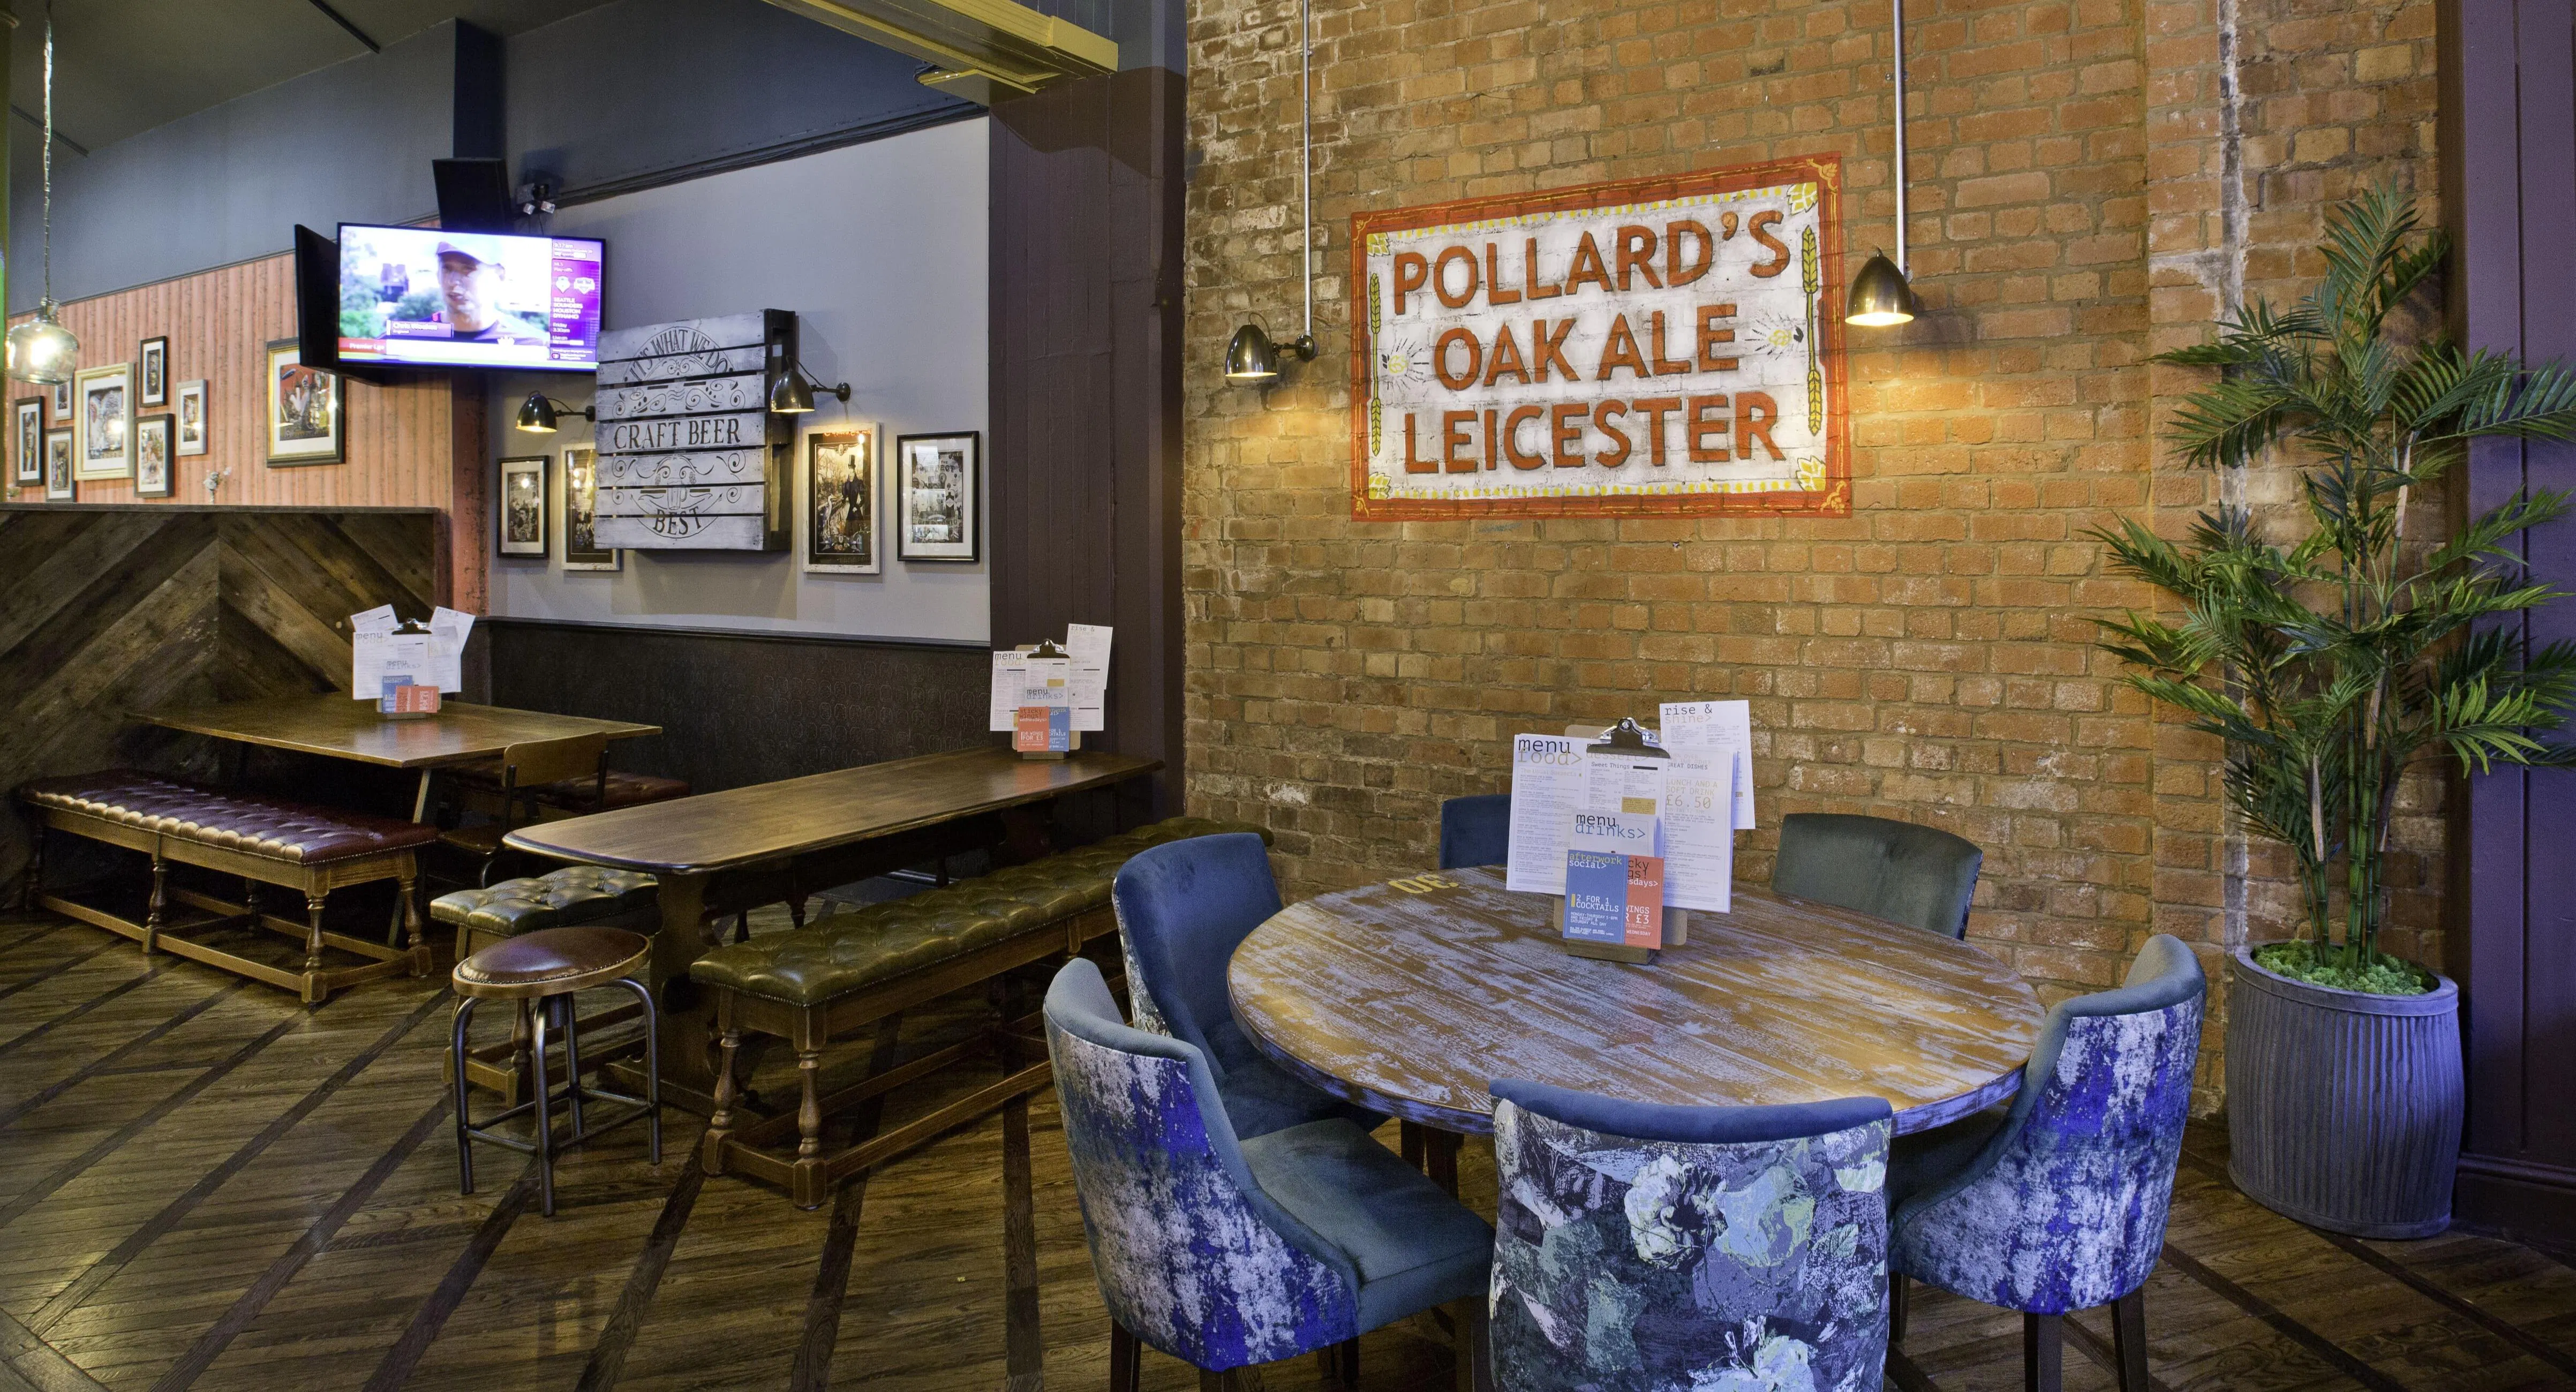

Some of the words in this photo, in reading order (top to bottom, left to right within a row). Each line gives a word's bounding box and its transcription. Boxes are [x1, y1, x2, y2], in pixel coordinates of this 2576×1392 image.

[1394, 209, 1791, 315] POLLARD'S
[1433, 317, 1581, 392] OAK
[1596, 303, 1739, 382] ALE
[630, 348, 653, 381] IT'S
[651, 329, 688, 360] WHAT
[689, 332, 710, 360] WE
[705, 347, 728, 374] DO
[614, 422, 681, 449] CRAFT
[688, 418, 741, 445] BEER
[1404, 390, 1787, 475] LEICESTER
[653, 506, 702, 535] BEST
[1665, 705, 1696, 716] rise
[1705, 704, 1713, 714] &
[1665, 714, 1712, 724] shine>
[1518, 739, 1571, 754] menu
[1518, 747, 1583, 766] food>
[1667, 778, 1692, 786] LUNCH
[1690, 788, 1714, 796] DRINK
[1576, 814, 1616, 827] menu
[1576, 821, 1646, 839] drinks>
[1569, 852, 1622, 864] afterwork
[1569, 860, 1607, 869] social>
[1628, 858, 1649, 871] cky
[1628, 870, 1647, 880] gs!
[1628, 878, 1659, 887] sdays>
[1576, 901, 1619, 912] COCKTAILS
[1636, 914, 1649, 924] £3
